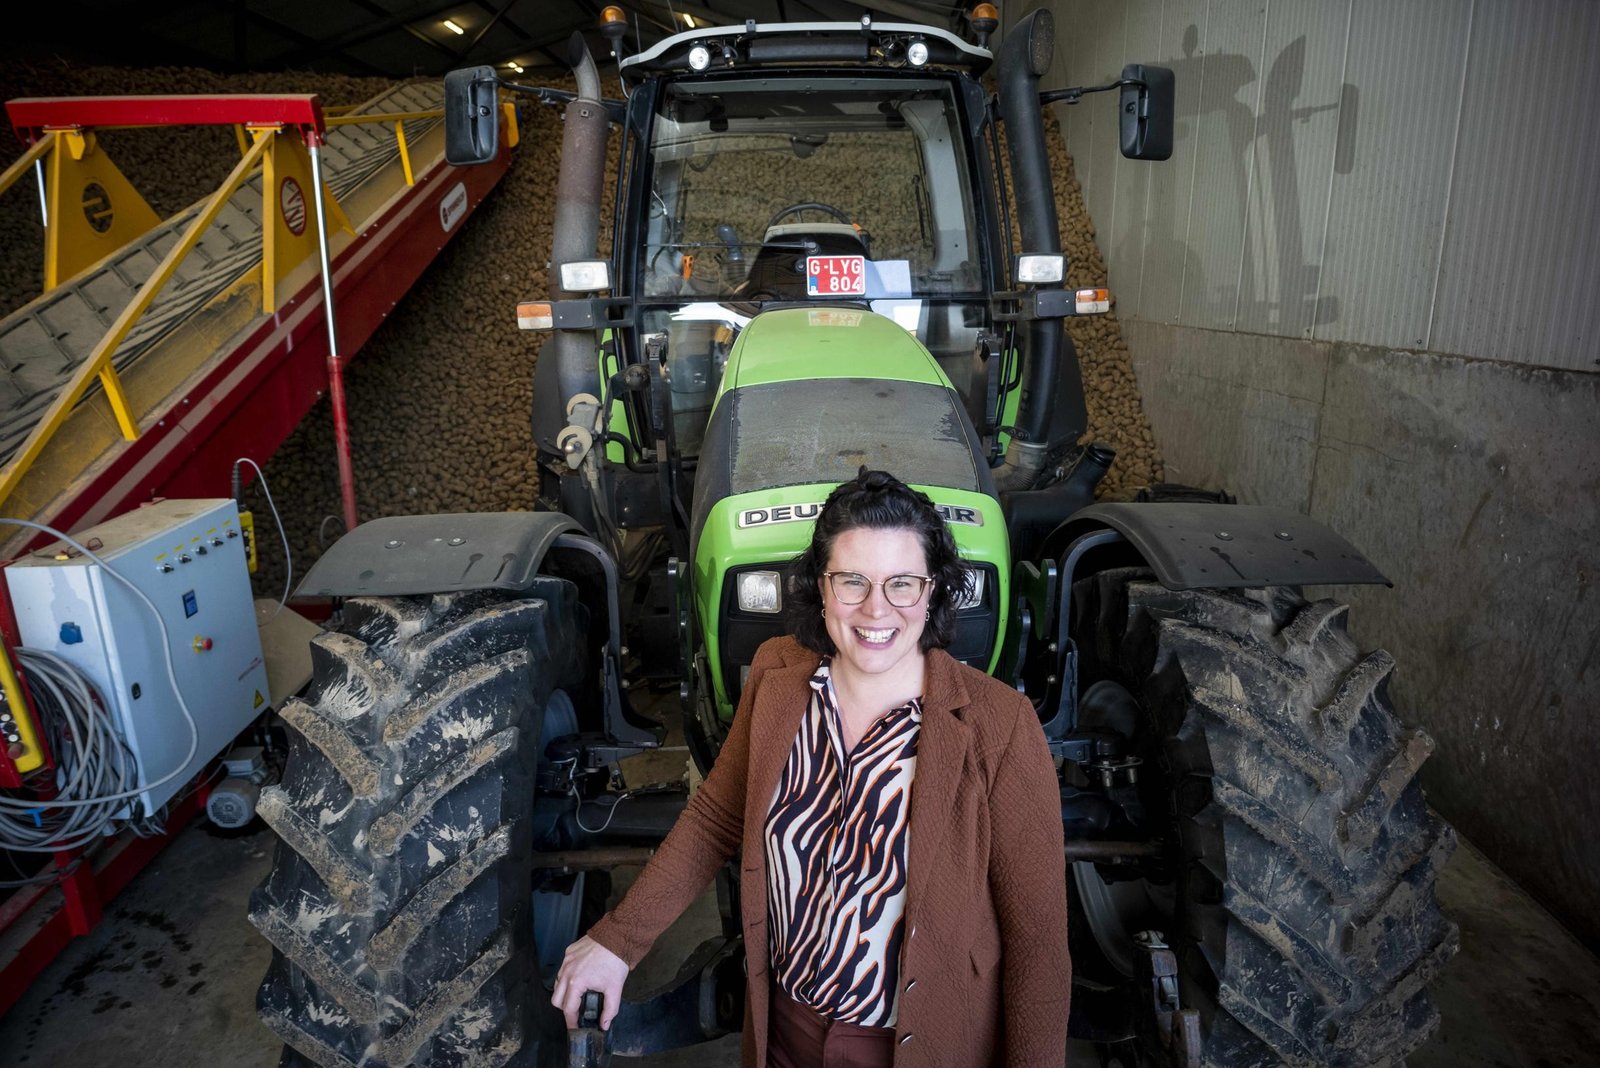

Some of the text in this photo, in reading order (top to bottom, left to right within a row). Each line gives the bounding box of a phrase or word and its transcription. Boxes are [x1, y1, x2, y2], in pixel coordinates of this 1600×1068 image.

[809, 259, 860, 274] G-LYG
[829, 275, 860, 291] 804
[745, 504, 825, 525] DEU
